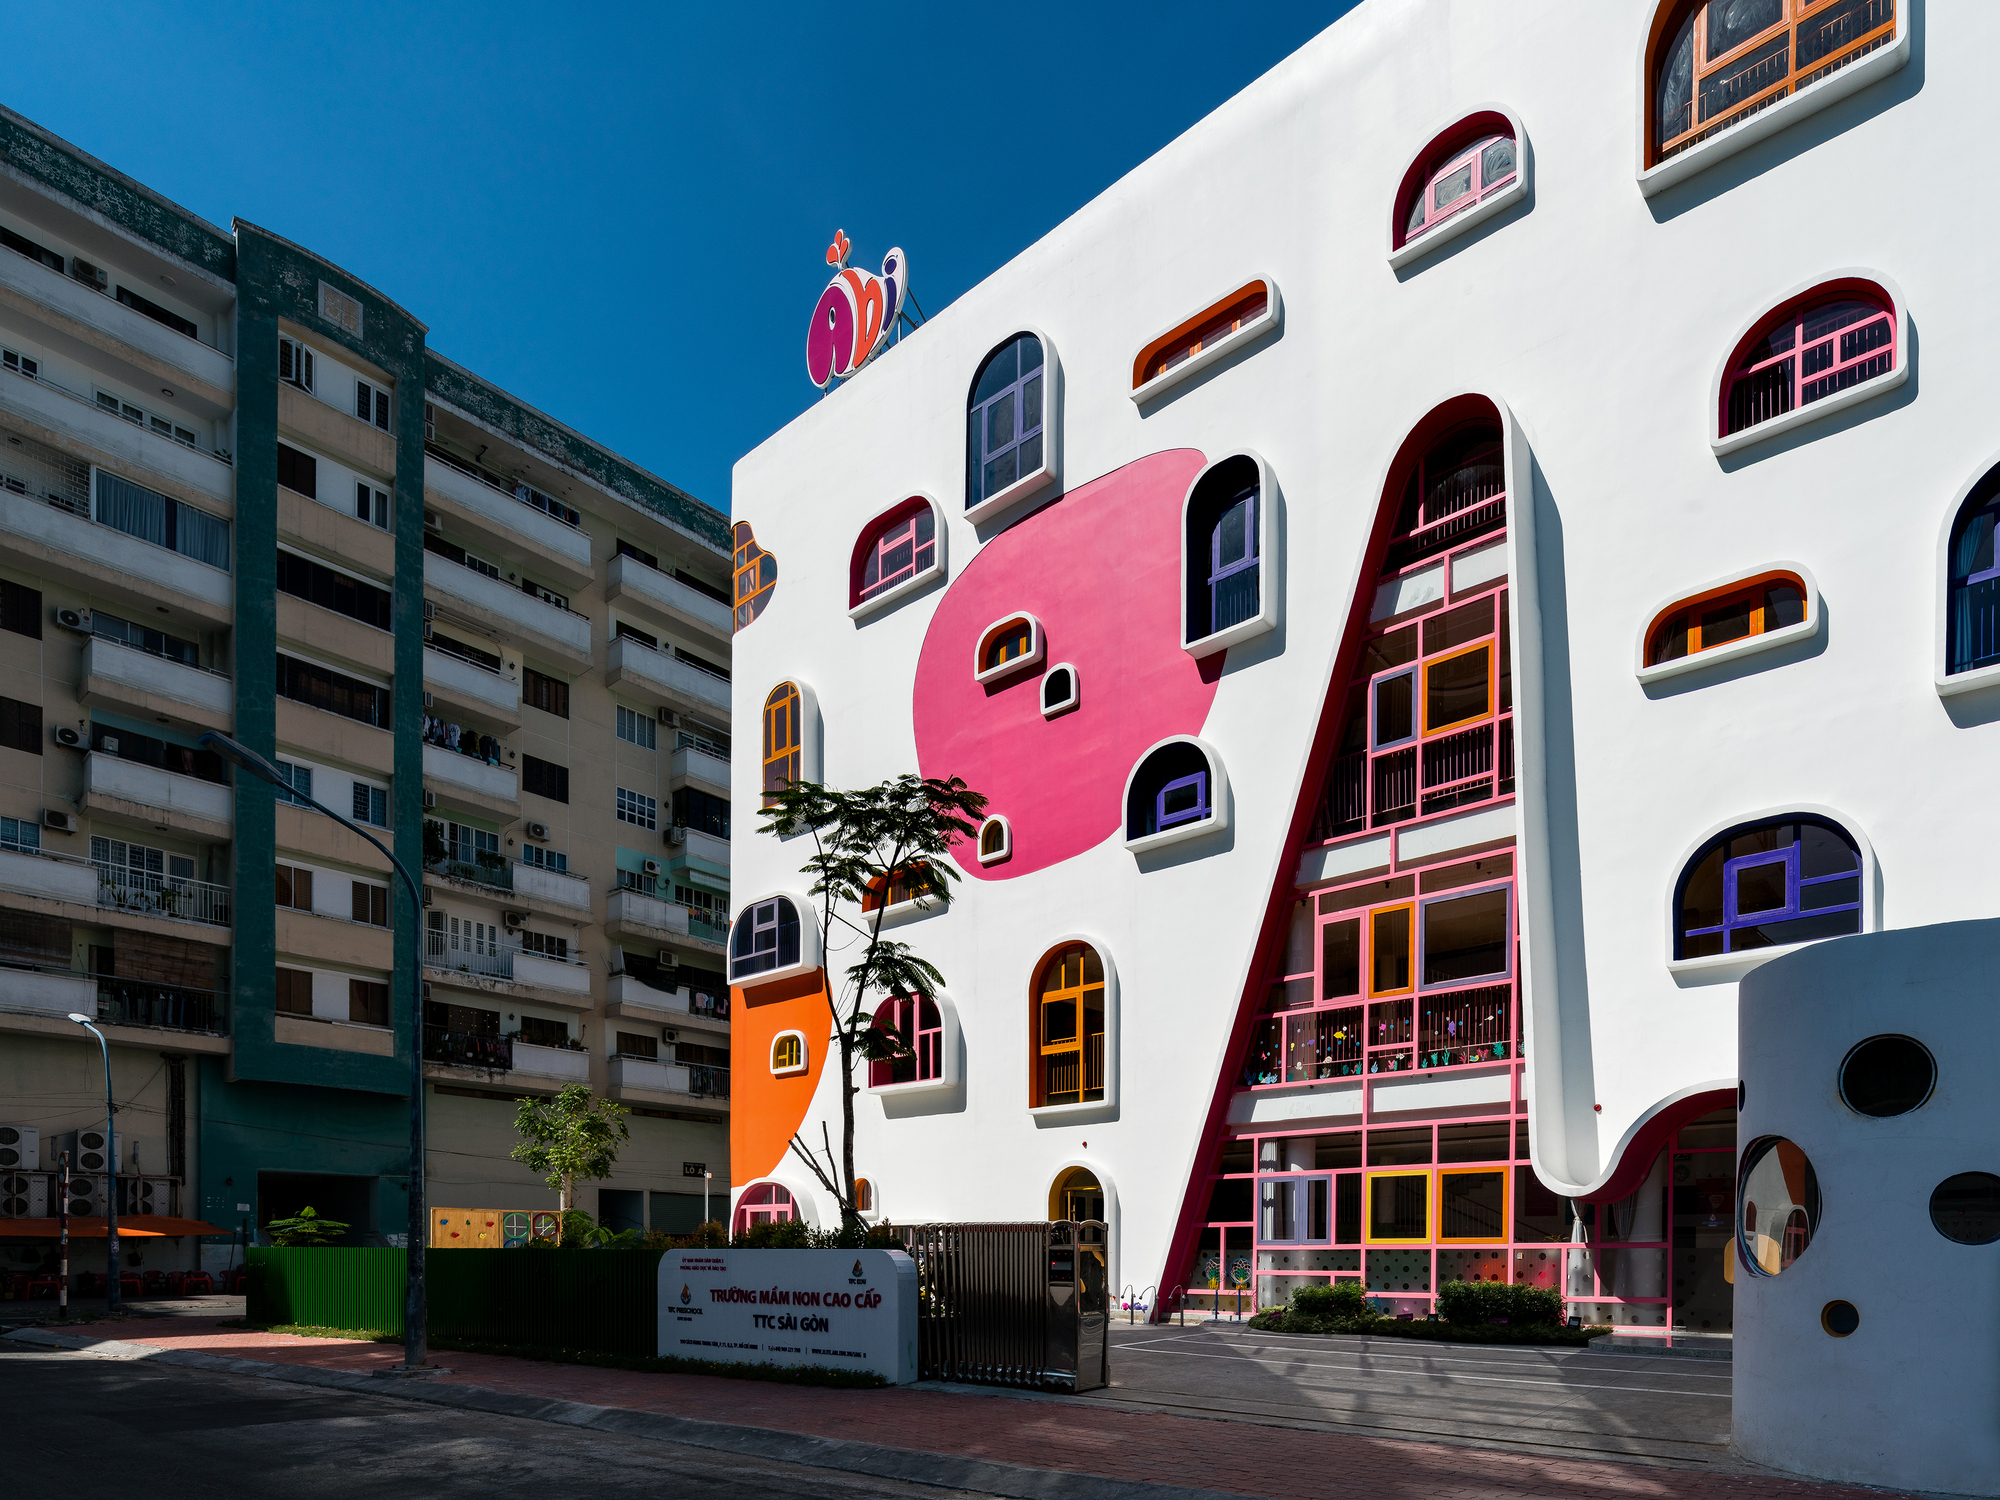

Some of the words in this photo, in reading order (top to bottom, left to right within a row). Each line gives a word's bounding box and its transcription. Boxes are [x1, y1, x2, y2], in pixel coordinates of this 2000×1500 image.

[685, 1166, 695, 1174] LÔ
[710, 1286, 756, 1304] TRƯỜNG
[759, 1286, 790, 1305] MẦM
[793, 1290, 820, 1307] NON
[823, 1292, 852, 1308] CAO
[854, 1288, 882, 1309] CẤP
[676, 1307, 703, 1315] PRESCHOOL
[753, 1314, 776, 1330] TTC
[777, 1312, 797, 1331] SÀI
[800, 1313, 829, 1333] GÒN
